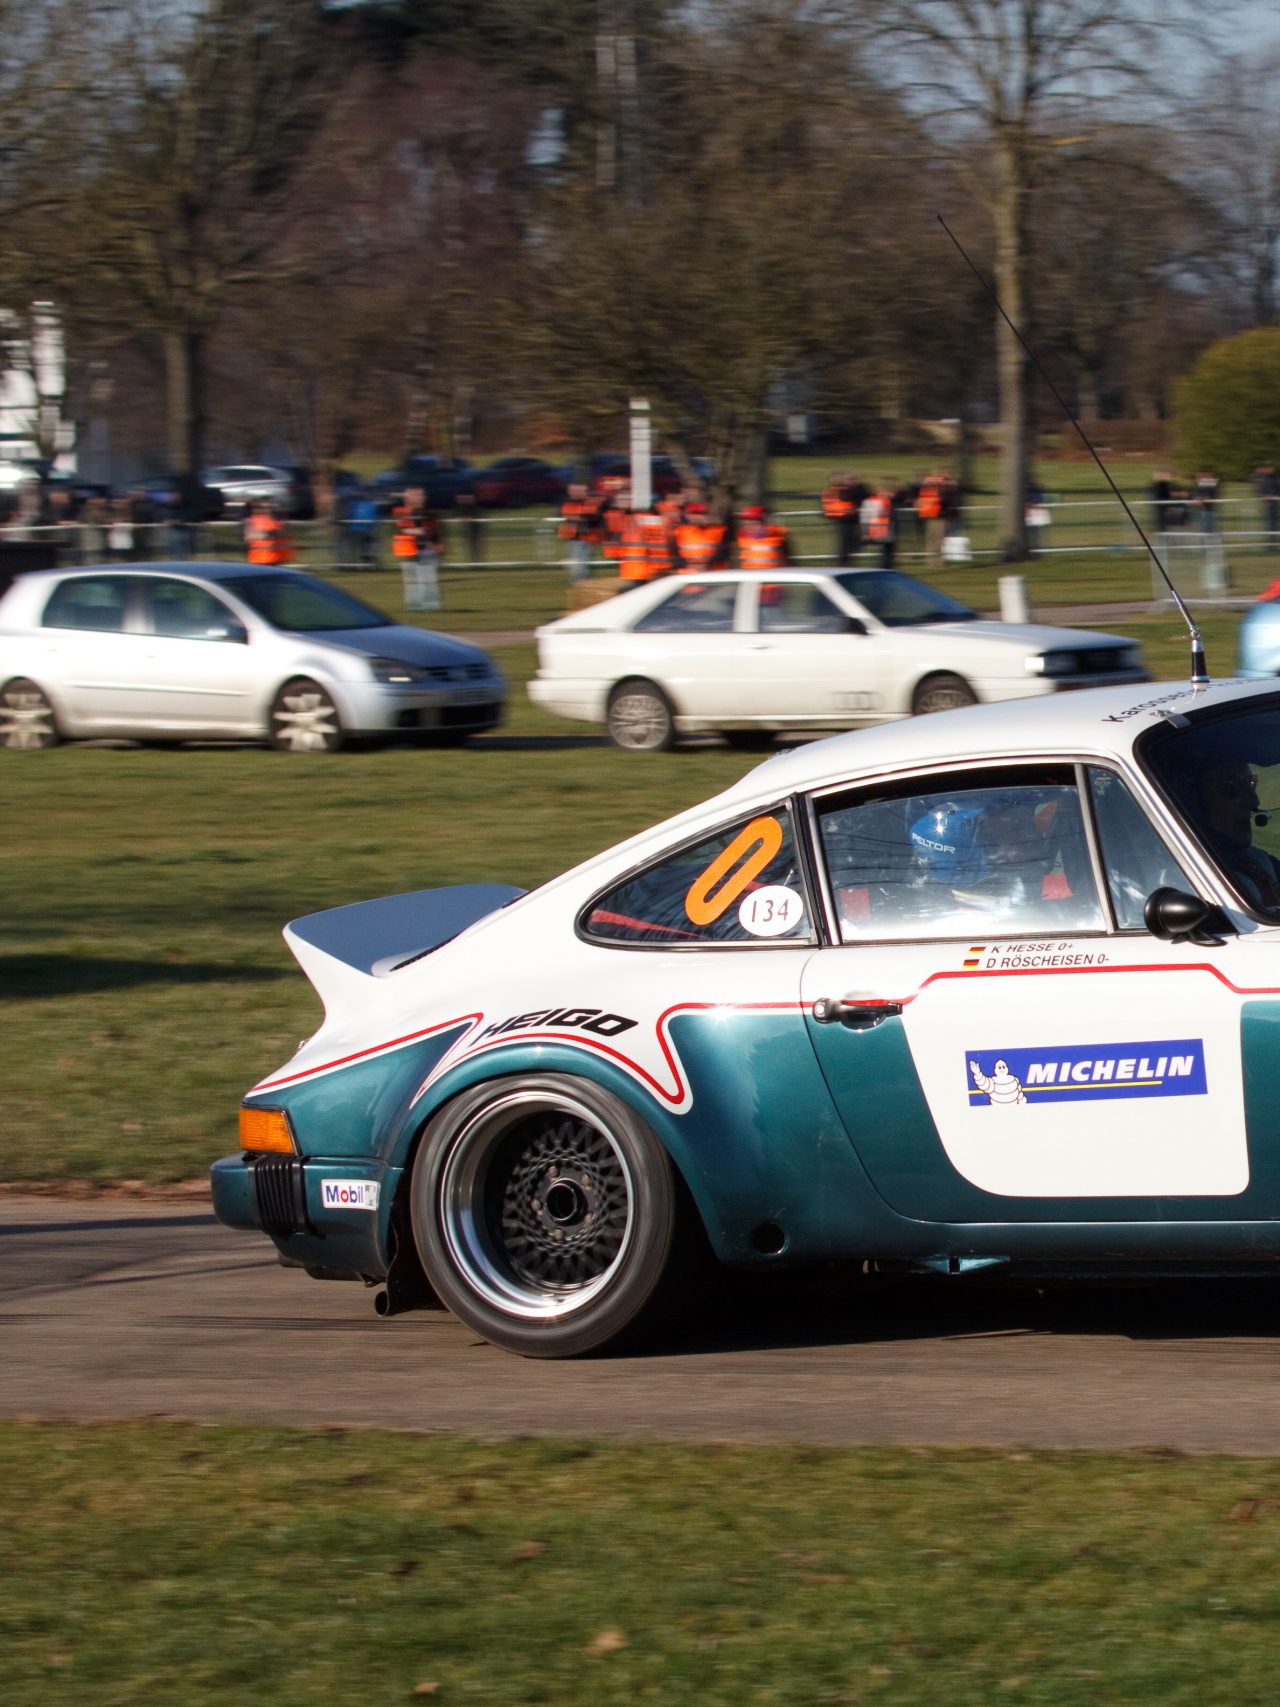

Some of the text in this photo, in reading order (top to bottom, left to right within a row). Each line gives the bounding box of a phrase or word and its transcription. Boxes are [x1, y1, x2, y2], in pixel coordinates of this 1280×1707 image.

[911, 832, 956, 853] PELTOR
[751, 898, 789, 923] 134
[990, 945, 1002, 954] K
[1006, 943, 1055, 953] HESSE
[986, 958, 996, 969] D
[1000, 954, 1094, 969] RÖSCHEISEN
[468, 1007, 639, 1048] HEIGO
[1026, 1055, 1194, 1084] MICHELIN
[325, 1184, 364, 1203] Mobil
